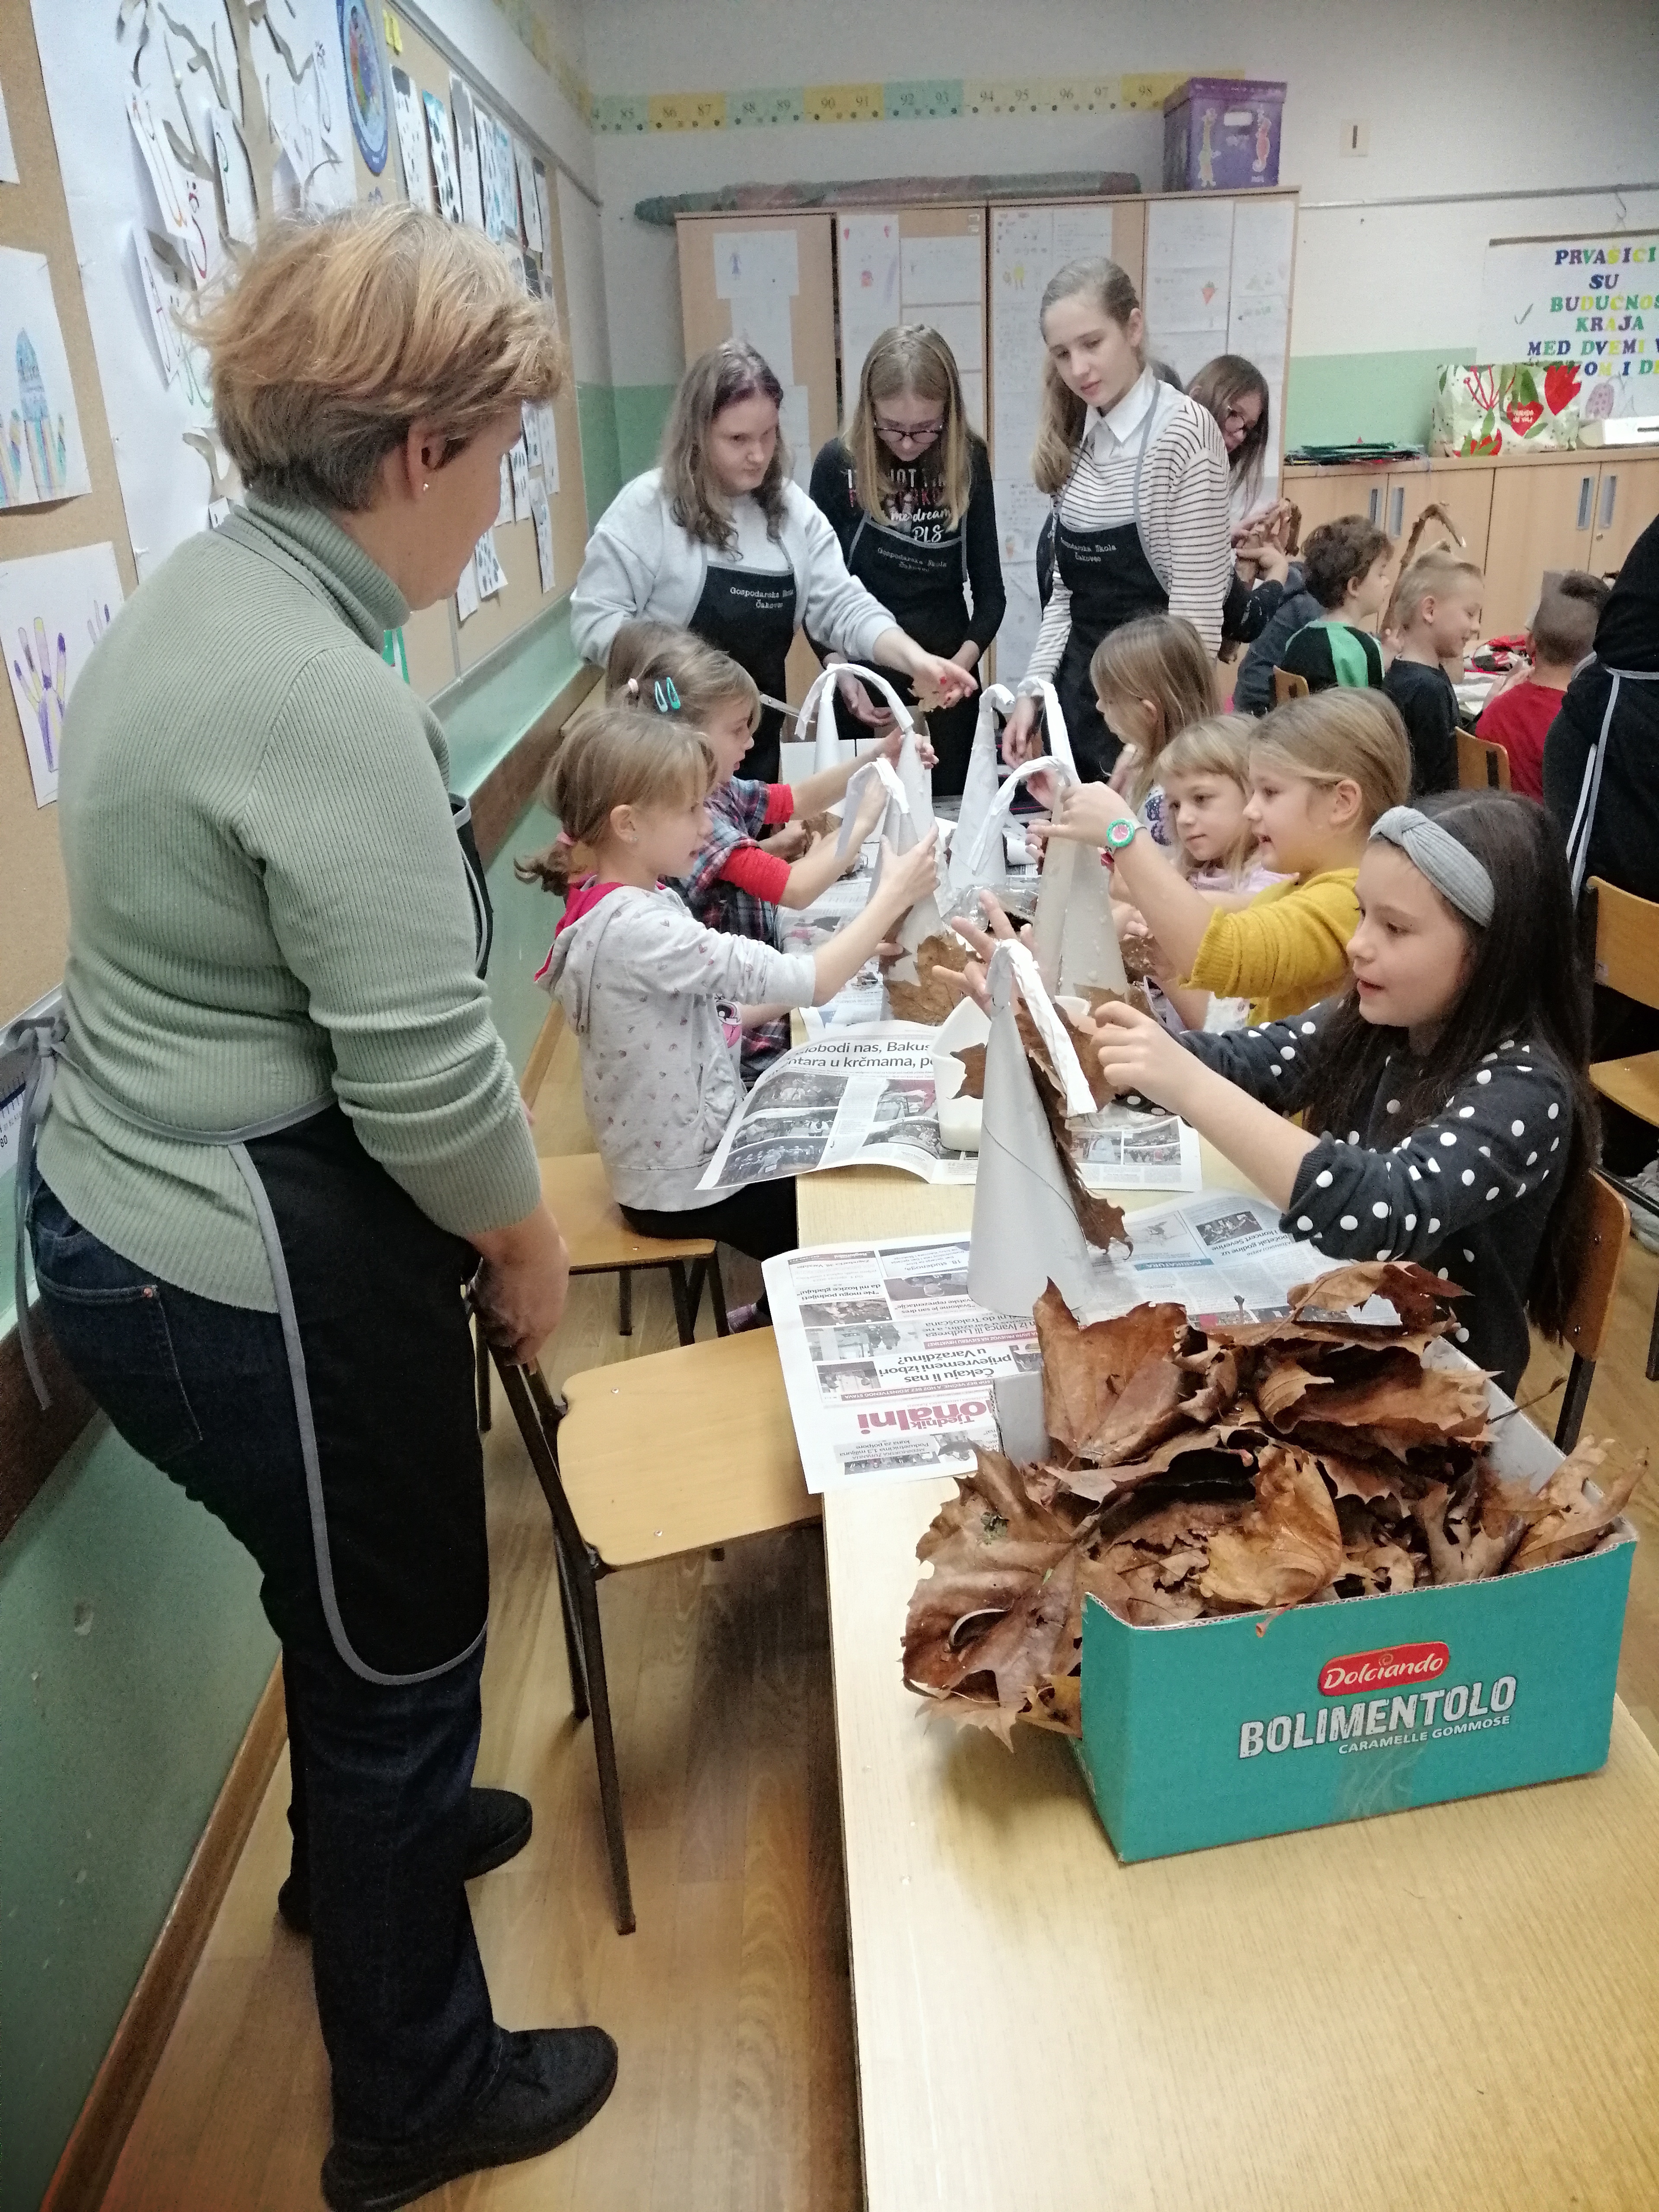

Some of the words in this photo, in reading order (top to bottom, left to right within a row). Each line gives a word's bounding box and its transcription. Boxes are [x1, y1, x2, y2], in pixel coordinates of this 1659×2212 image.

[980, 90, 993, 102] 94
[821, 97, 836, 109] 90
[1589, 273, 1619, 289] SU
[1576, 315, 1644, 332] KRAJA
[1581, 339, 1644, 356] DVEMI
[1622, 361, 1631, 376] I
[912, 525, 944, 543] PLS
[854, 1045, 882, 1053] nas,
[887, 1042, 930, 1052] Bakus
[843, 1056, 916, 1068] krčmama,
[1244, 1230, 1274, 1242] koncert
[1258, 1234, 1288, 1246] početak
[1211, 1239, 1244, 1251] Severine
[1231, 1242, 1257, 1254] godine
[904, 1262, 947, 1271] studenoga,
[801, 1293, 837, 1301] podnijeti
[925, 1328, 973, 1337] Ludbrega
[897, 1349, 976, 1364] Varaždinu?
[919, 1354, 1012, 1372] prijevremeni
[878, 1366, 919, 1377] izbori
[932, 1373, 941, 1382] li
[944, 1368, 994, 1382] Čekaju
[904, 1374, 929, 1383] nas
[864, 1389, 909, 1397] JEDINSTVENOG
[909, 1414, 975, 1429] Tjednik
[879, 1443, 929, 1452] Poduzetnicima
[1323, 1653, 1443, 1691] Dolciando
[1238, 1675, 1519, 1760] BOLIMENTOLO
[1337, 1732, 1429, 1755] CARAMELLE
[1431, 1714, 1512, 1739] GOMMOSE
